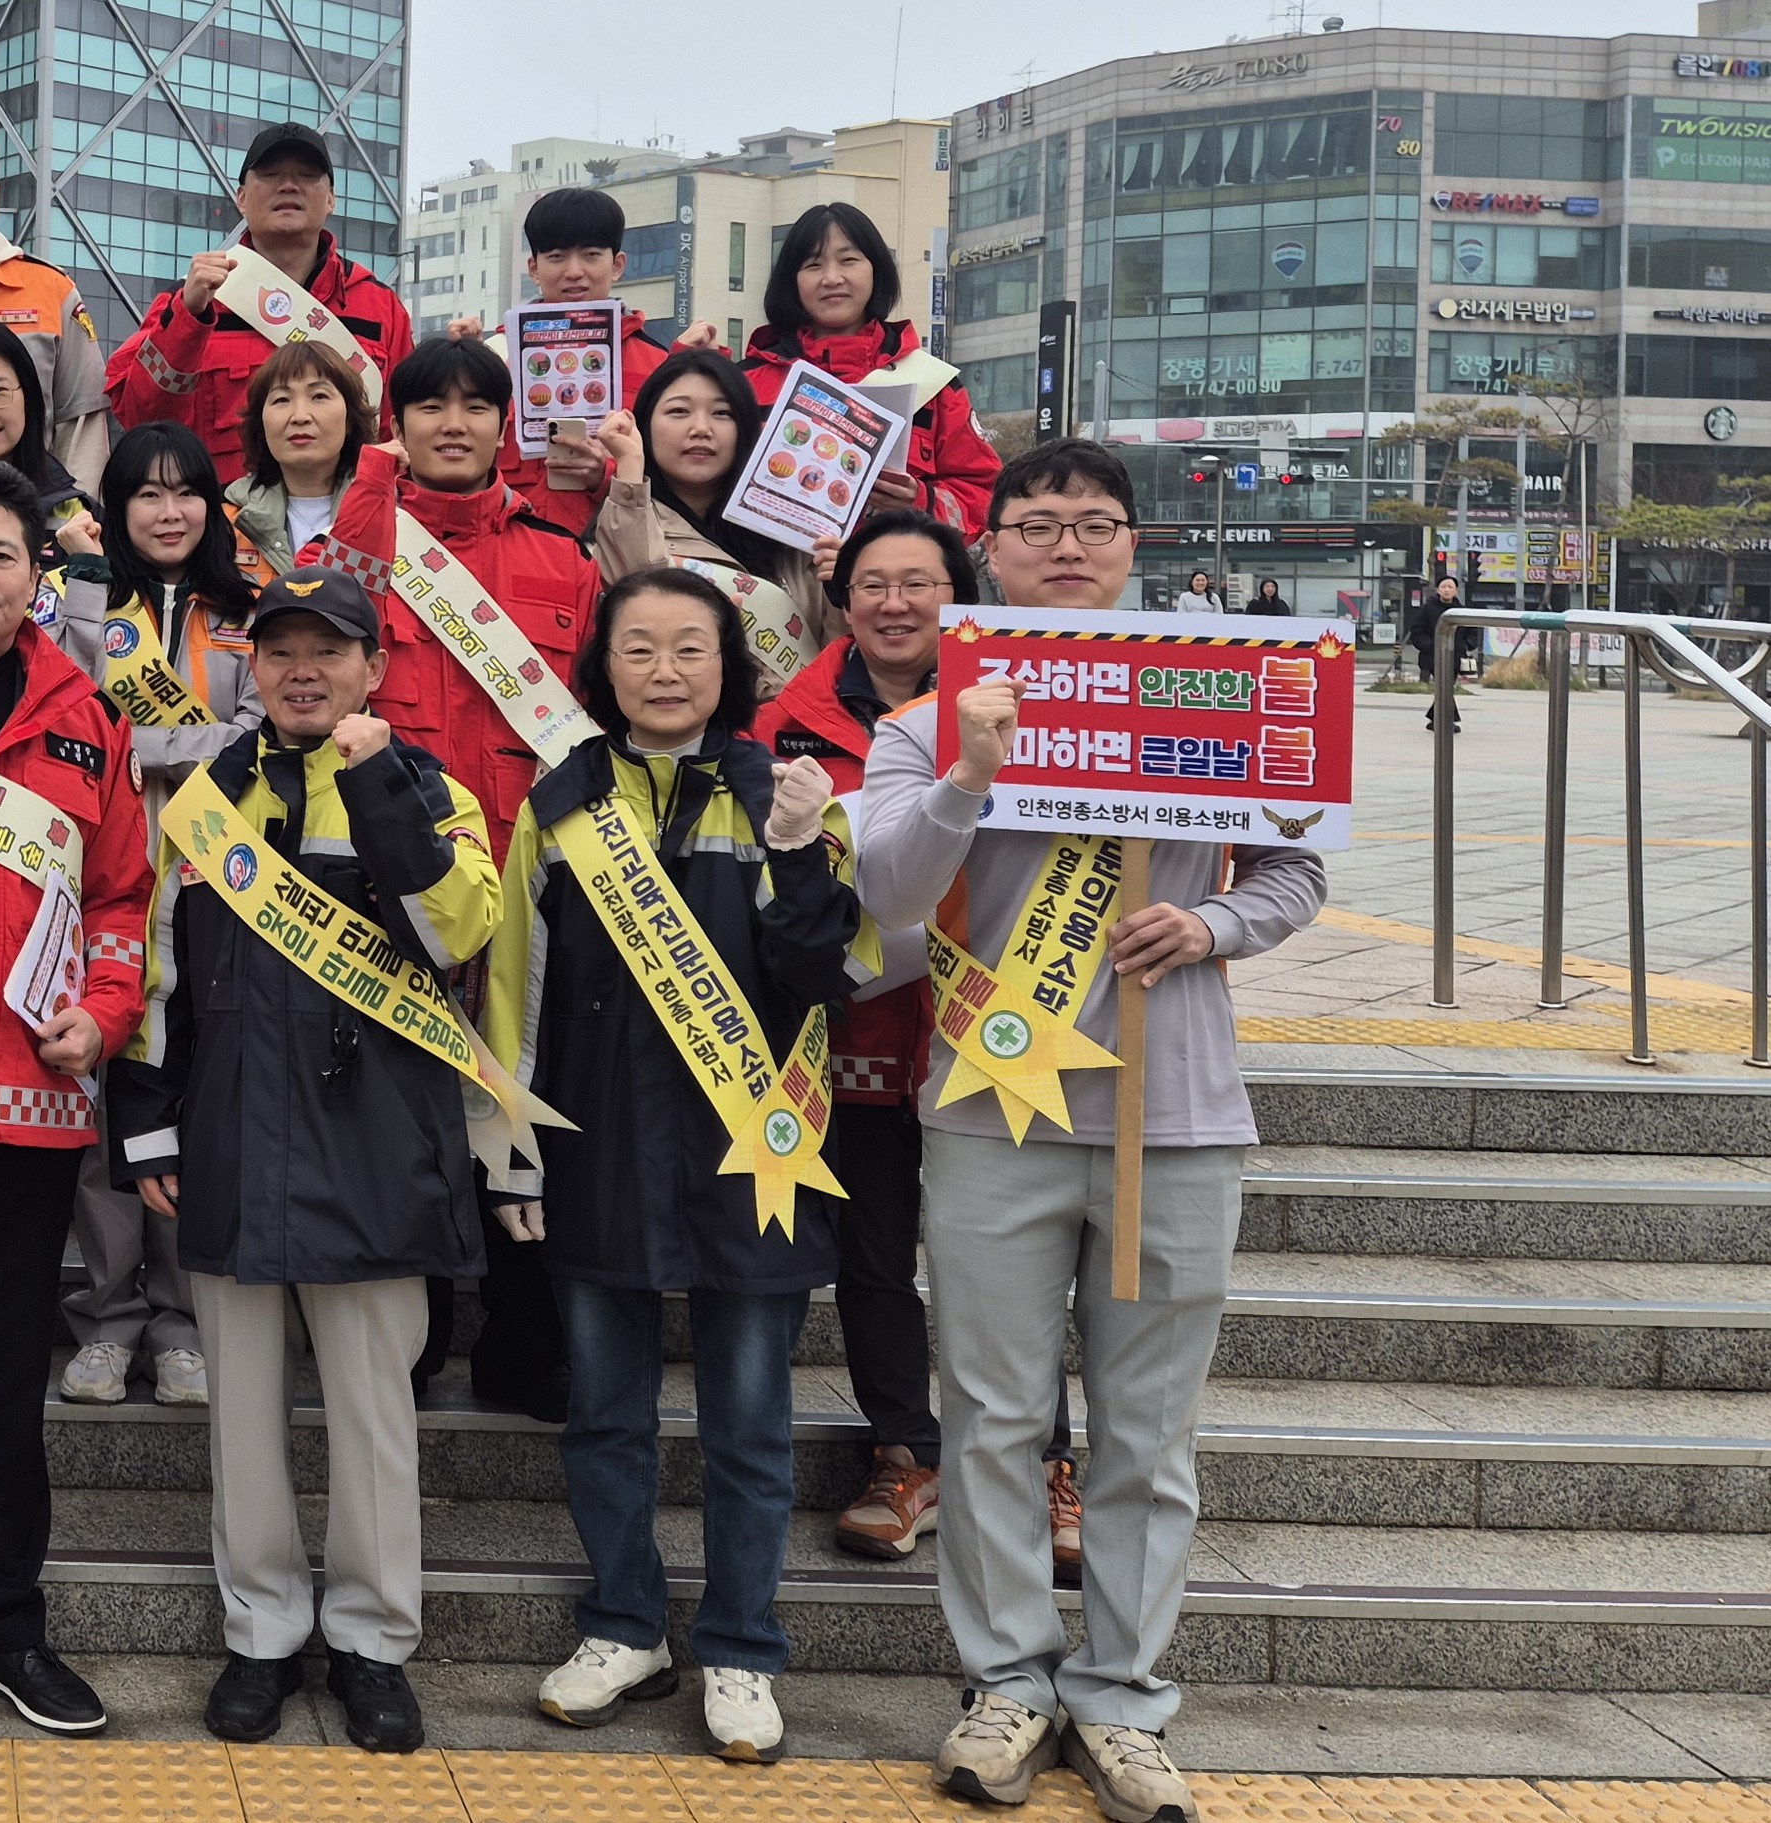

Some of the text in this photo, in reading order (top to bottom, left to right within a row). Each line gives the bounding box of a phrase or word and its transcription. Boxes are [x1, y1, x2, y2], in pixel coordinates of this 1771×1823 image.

[1236, 52, 1308, 79] 7080
[1377, 115, 1402, 132] 70
[1397, 139, 1421, 156] 80
[1451, 191, 1542, 213] RE/MAX
[677, 233, 691, 327] DK Airport Hotel
[1523, 474, 1563, 491] HAIR
[405, 574, 434, 600] 그
[429, 595, 489, 660] 사랑의
[485, 655, 524, 702] 시작
[140, 657, 188, 709] 살핀
[1138, 666, 1256, 711] 안전한
[1258, 655, 1318, 717] 불
[1001, 725, 1317, 787] 마하면 큰일날 불
[1016, 798, 1251, 832] 인천영종소방서 의용소방대
[19, 840, 44, 871] 숲
[272, 870, 339, 931] 살핀
[336, 920, 405, 976] 만큼
[1013, 846, 1083, 966] 영종소방서
[255, 901, 472, 1067] 잊은 만큼 위험한
[591, 869, 735, 1089] 인천광역시 영종소방서
[954, 964, 999, 1011] 불
[940, 997, 977, 1042] 불
[781, 1058, 814, 1106] 불
[802, 1091, 829, 1138] 불
